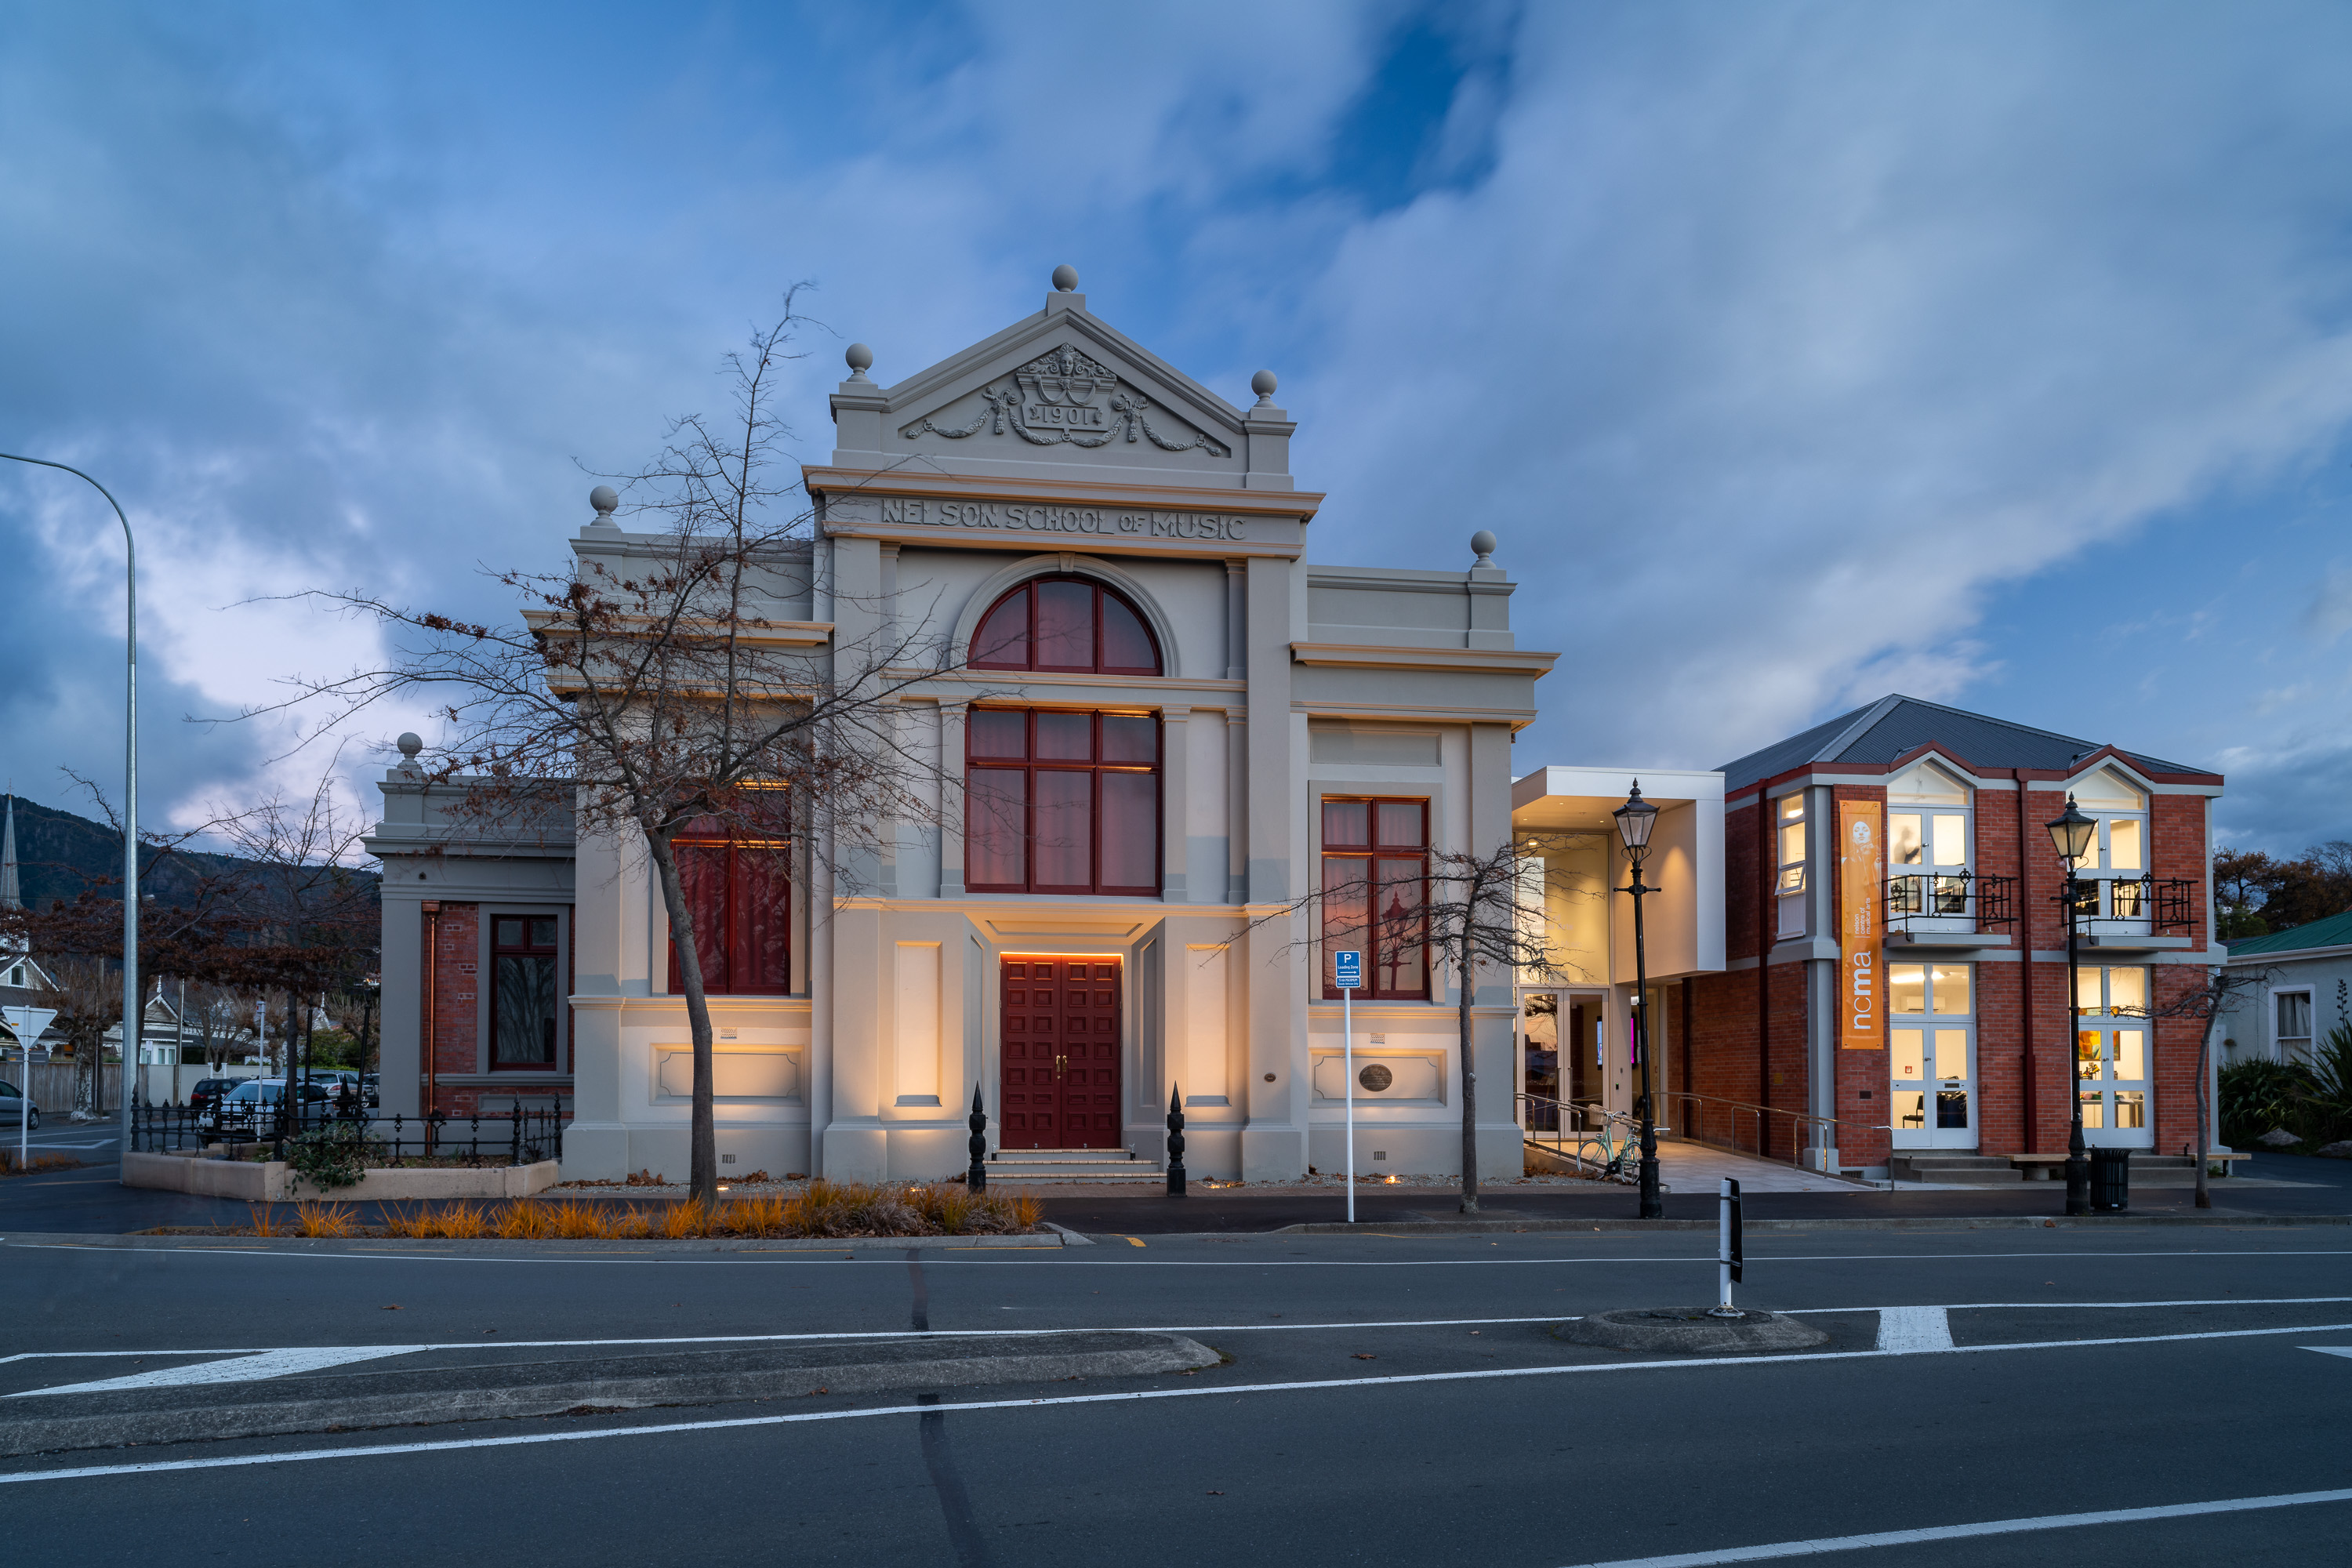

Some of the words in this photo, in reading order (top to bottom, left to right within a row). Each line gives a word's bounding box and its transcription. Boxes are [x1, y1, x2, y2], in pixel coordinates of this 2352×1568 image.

[1044, 407, 1088, 425] 1901
[883, 499, 999, 528] NELSON
[1006, 505, 1114, 535] SCHOOL
[1120, 514, 1145, 532] OF
[1152, 511, 1246, 540] MUSIC
[1344, 953, 1352, 964] P
[1853, 950, 1871, 1029] ncma
